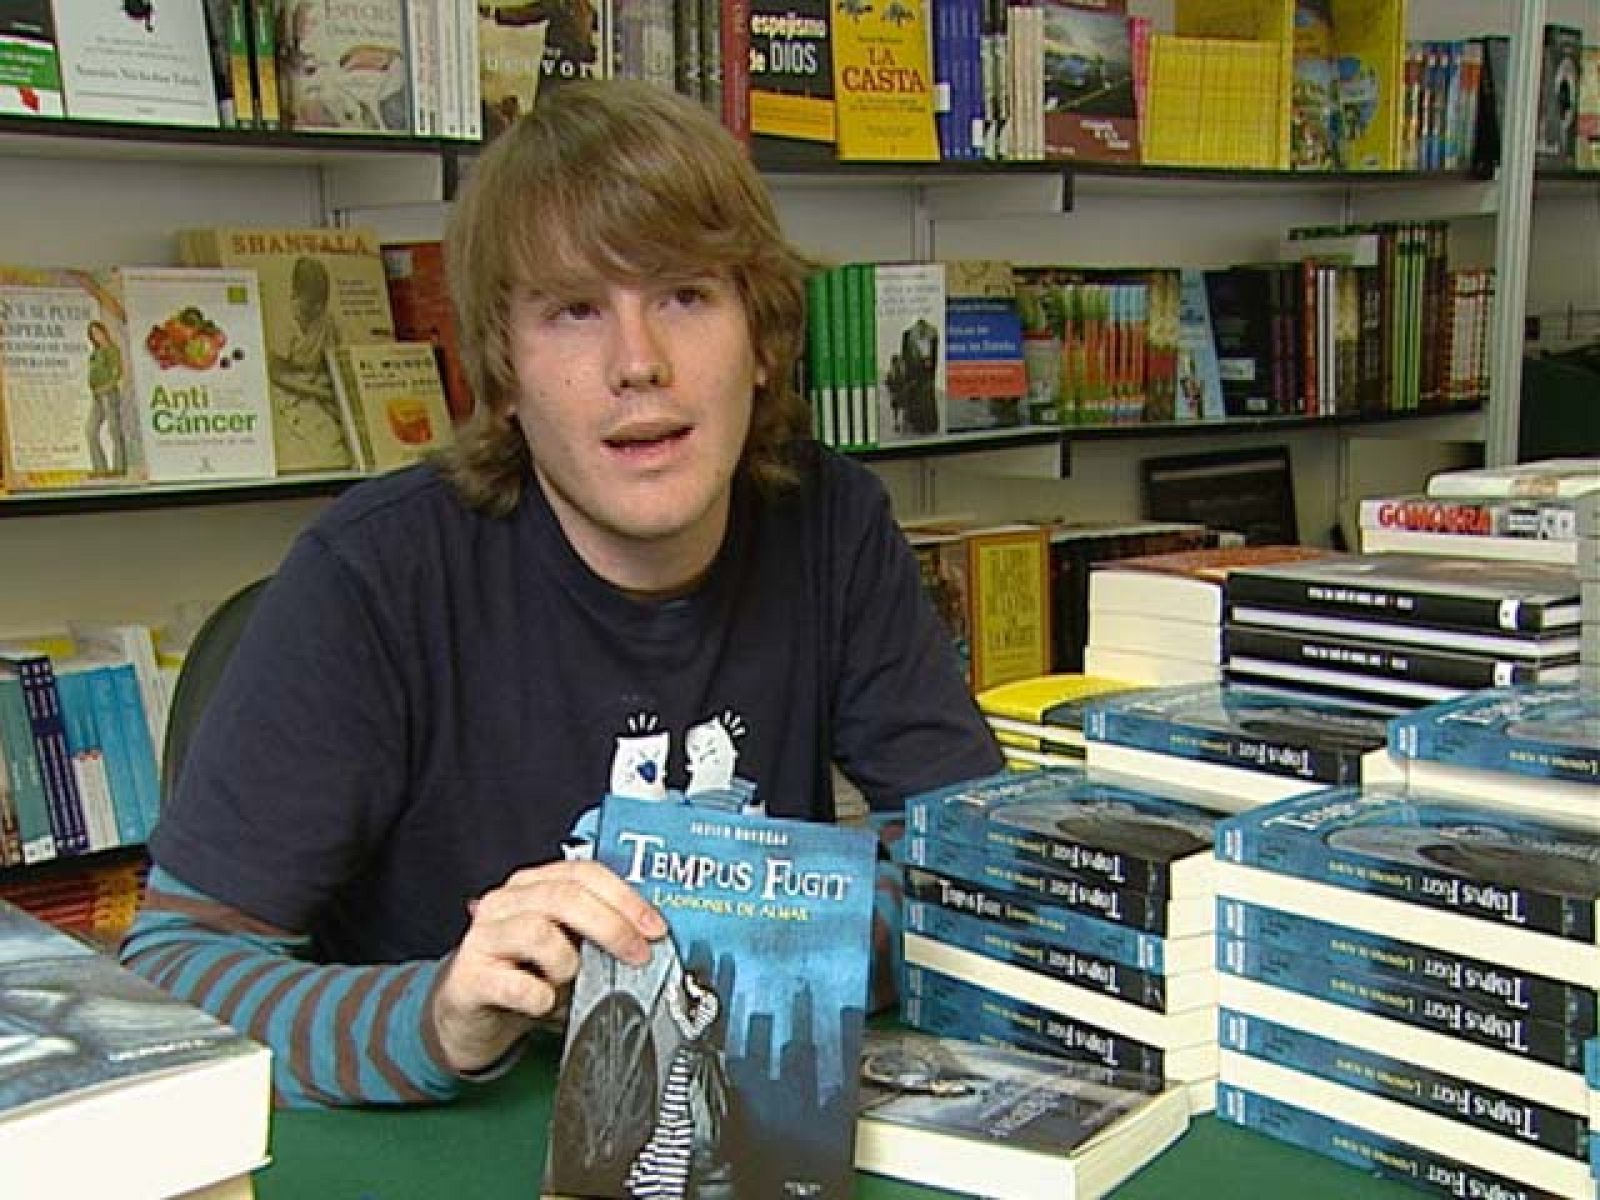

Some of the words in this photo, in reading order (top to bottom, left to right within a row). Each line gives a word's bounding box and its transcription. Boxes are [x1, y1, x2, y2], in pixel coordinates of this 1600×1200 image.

[752, 12, 826, 39] espejismo
[770, 40, 817, 74] DIOS
[868, 47, 896, 66] LA
[842, 65, 927, 92] CASTA
[150, 384, 208, 409] Anti
[153, 409, 257, 433] Cáncer
[618, 831, 753, 891] TEMPUS
[760, 856, 853, 901] FUGIT
